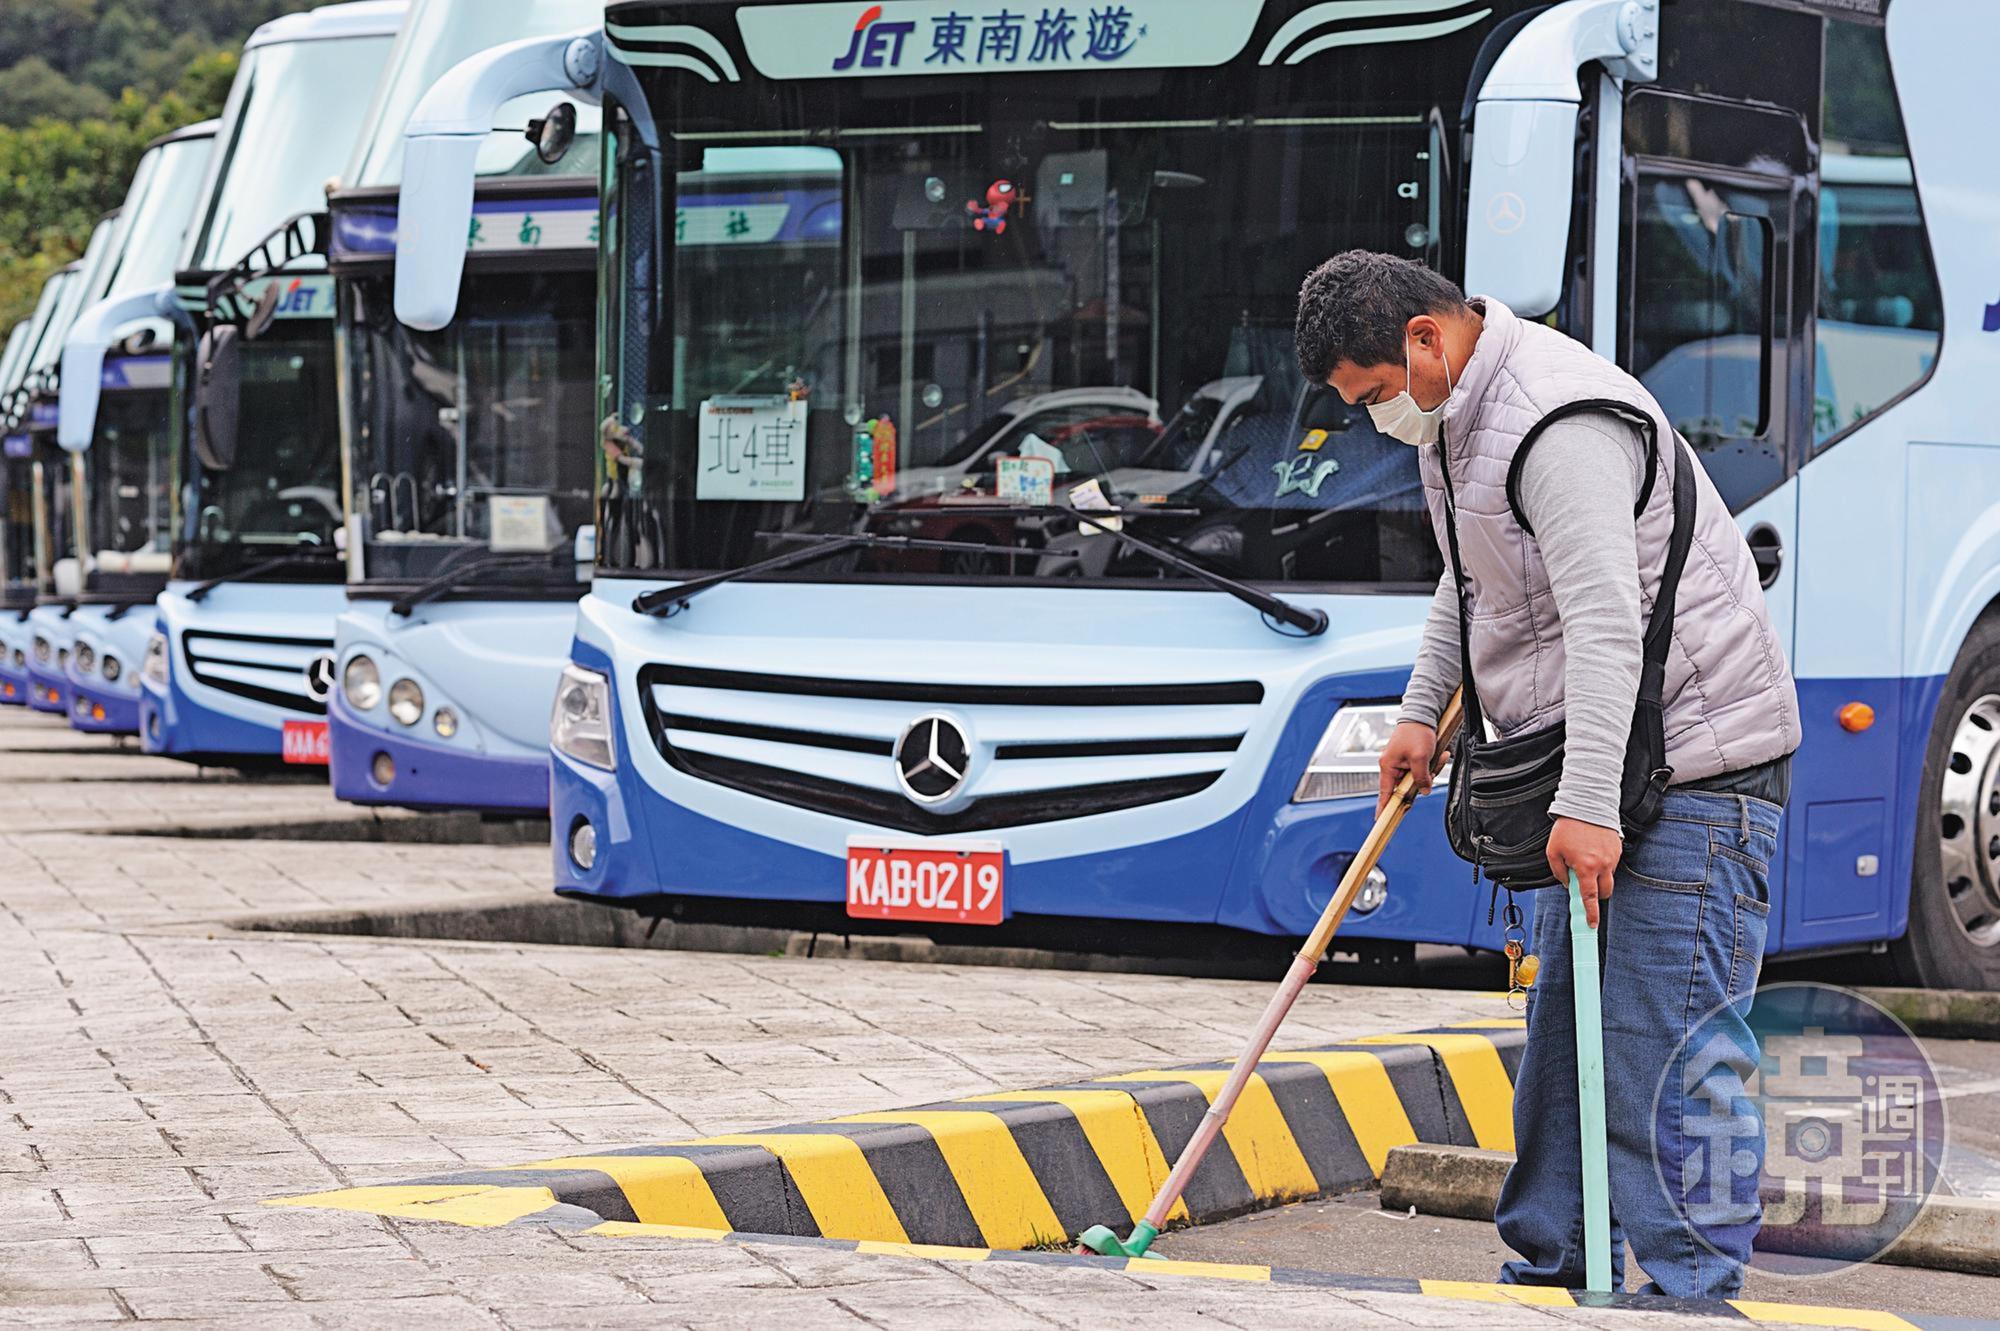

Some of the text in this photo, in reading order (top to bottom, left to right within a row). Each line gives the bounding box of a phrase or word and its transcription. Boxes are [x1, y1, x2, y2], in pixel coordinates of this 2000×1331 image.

[832, 5, 1137, 70] JET 東南旅遊
[277, 278, 317, 312] JET
[707, 418, 796, 477] 北4車
[849, 858, 1000, 911] KAB-0219
